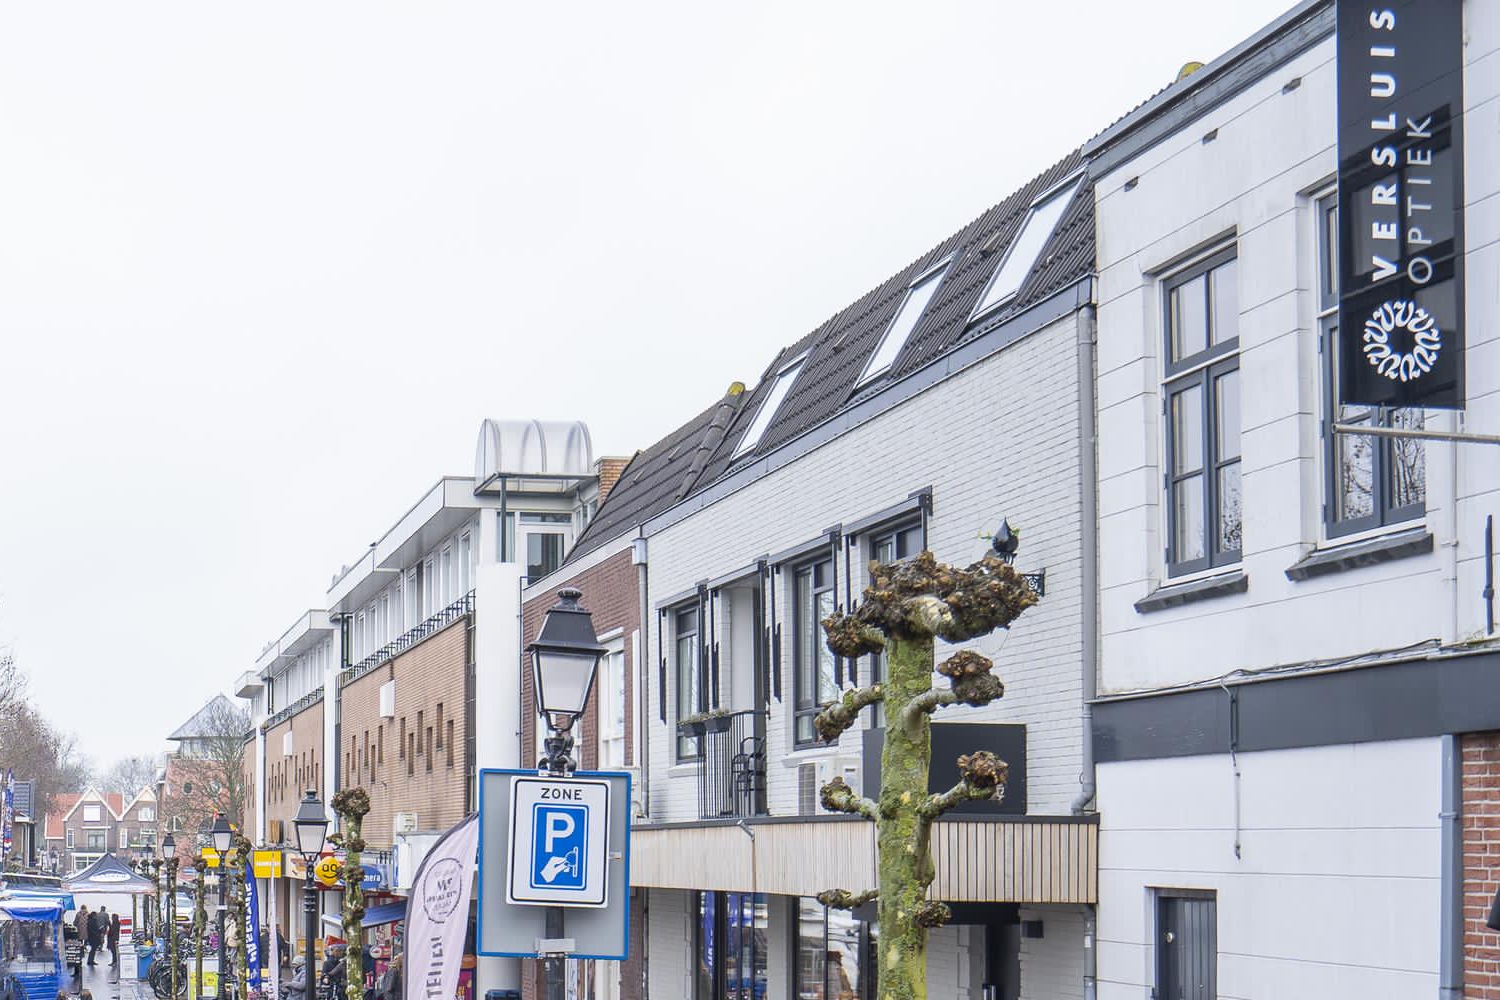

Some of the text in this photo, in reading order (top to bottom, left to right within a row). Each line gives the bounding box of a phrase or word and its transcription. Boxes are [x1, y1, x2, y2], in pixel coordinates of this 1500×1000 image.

[1370, 9, 1398, 283] VERSLUIS
[1406, 115, 1434, 285] OPTIEK
[540, 787, 583, 801] ZONE
[545, 811, 576, 854] P
